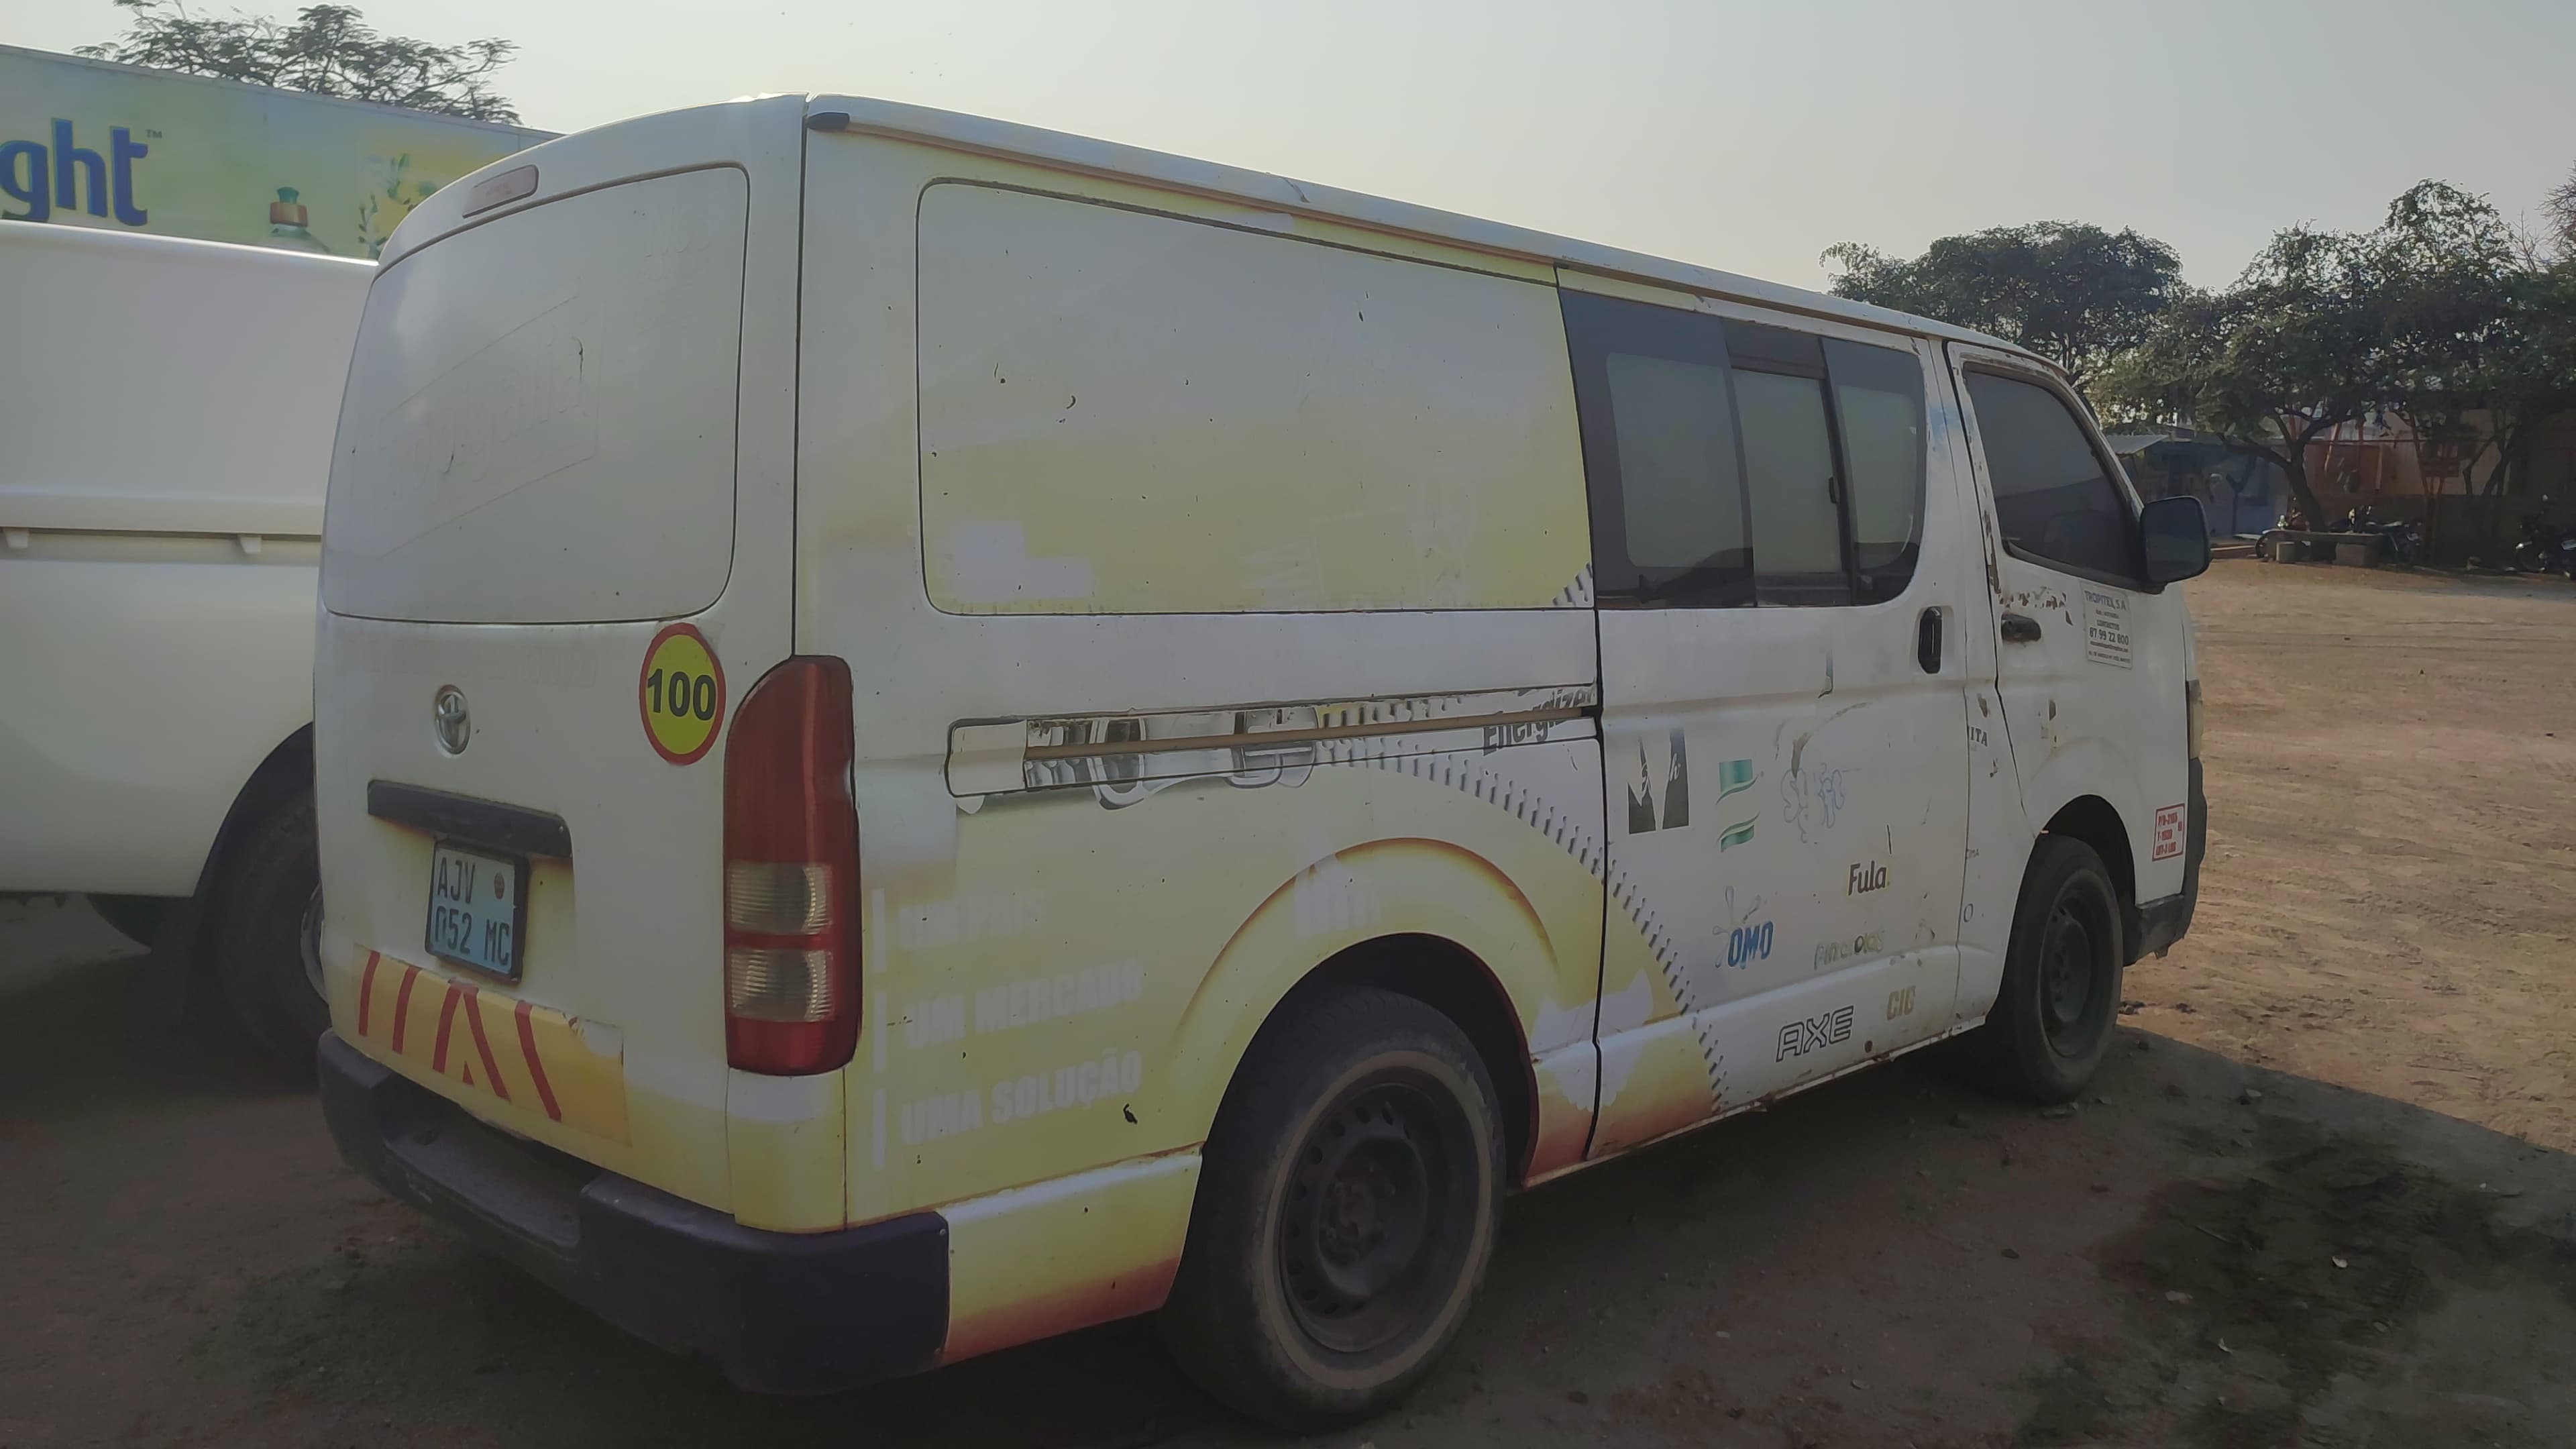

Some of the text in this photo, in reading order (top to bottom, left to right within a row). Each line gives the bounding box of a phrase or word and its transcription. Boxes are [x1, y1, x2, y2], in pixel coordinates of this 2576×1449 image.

[2108, 631, 2116, 643] 22
[646, 668, 716, 722] 100
[437, 857, 476, 904] AJV
[1847, 860, 1888, 896] Fula
[435, 906, 510, 967] 052 MC
[1727, 920, 1775, 969] OMO
[1776, 1005, 1855, 1063] AXE
[900, 1046, 1143, 1146] UMA SOLUÇÃO
